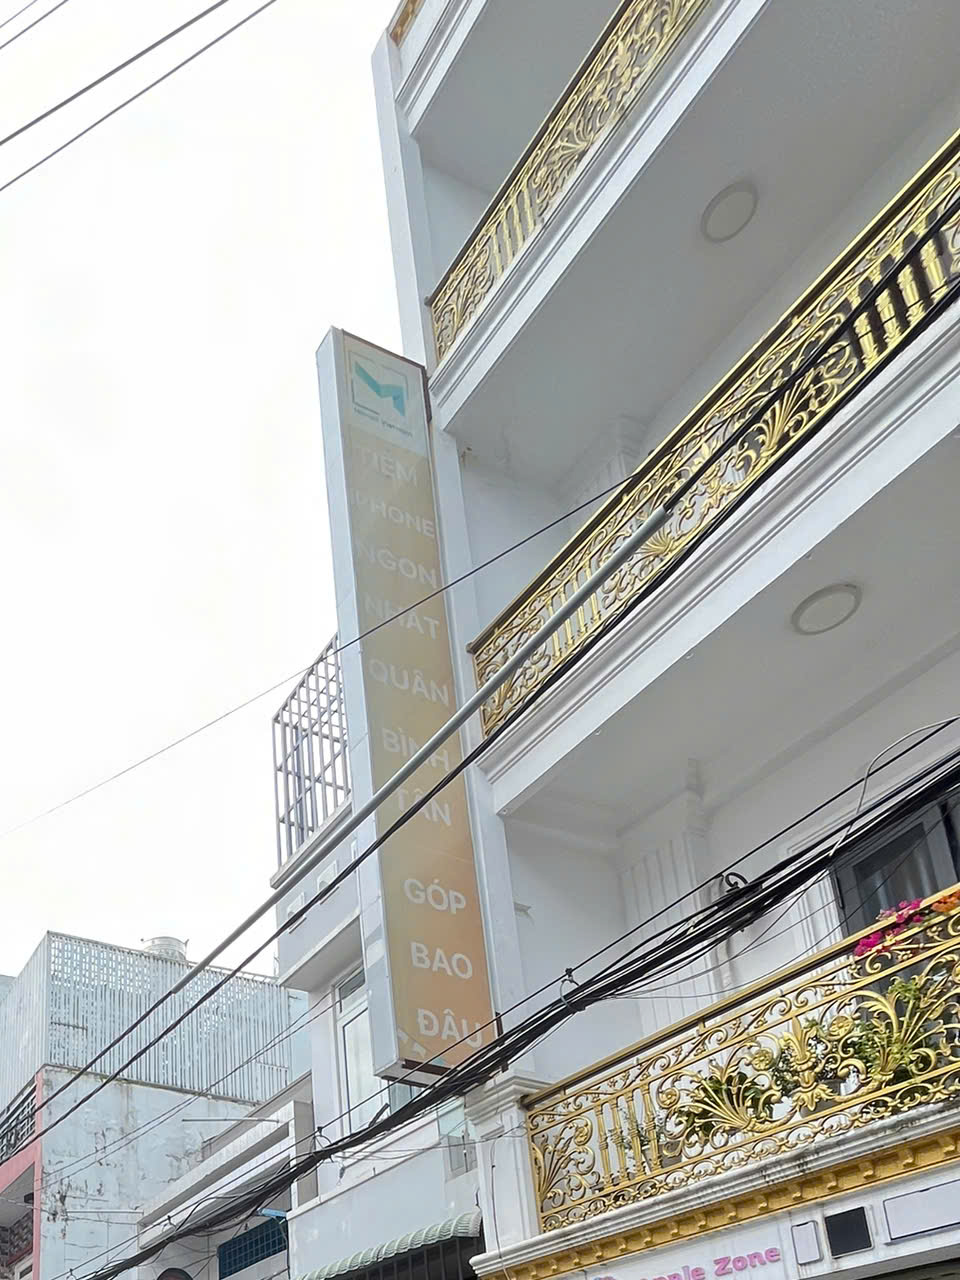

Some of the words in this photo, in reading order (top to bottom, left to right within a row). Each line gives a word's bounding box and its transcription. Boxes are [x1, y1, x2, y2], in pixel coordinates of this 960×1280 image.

[403, 877, 467, 915] GÓP
[410, 941, 473, 980] BAO
[713, 1247, 781, 1277] Zone
